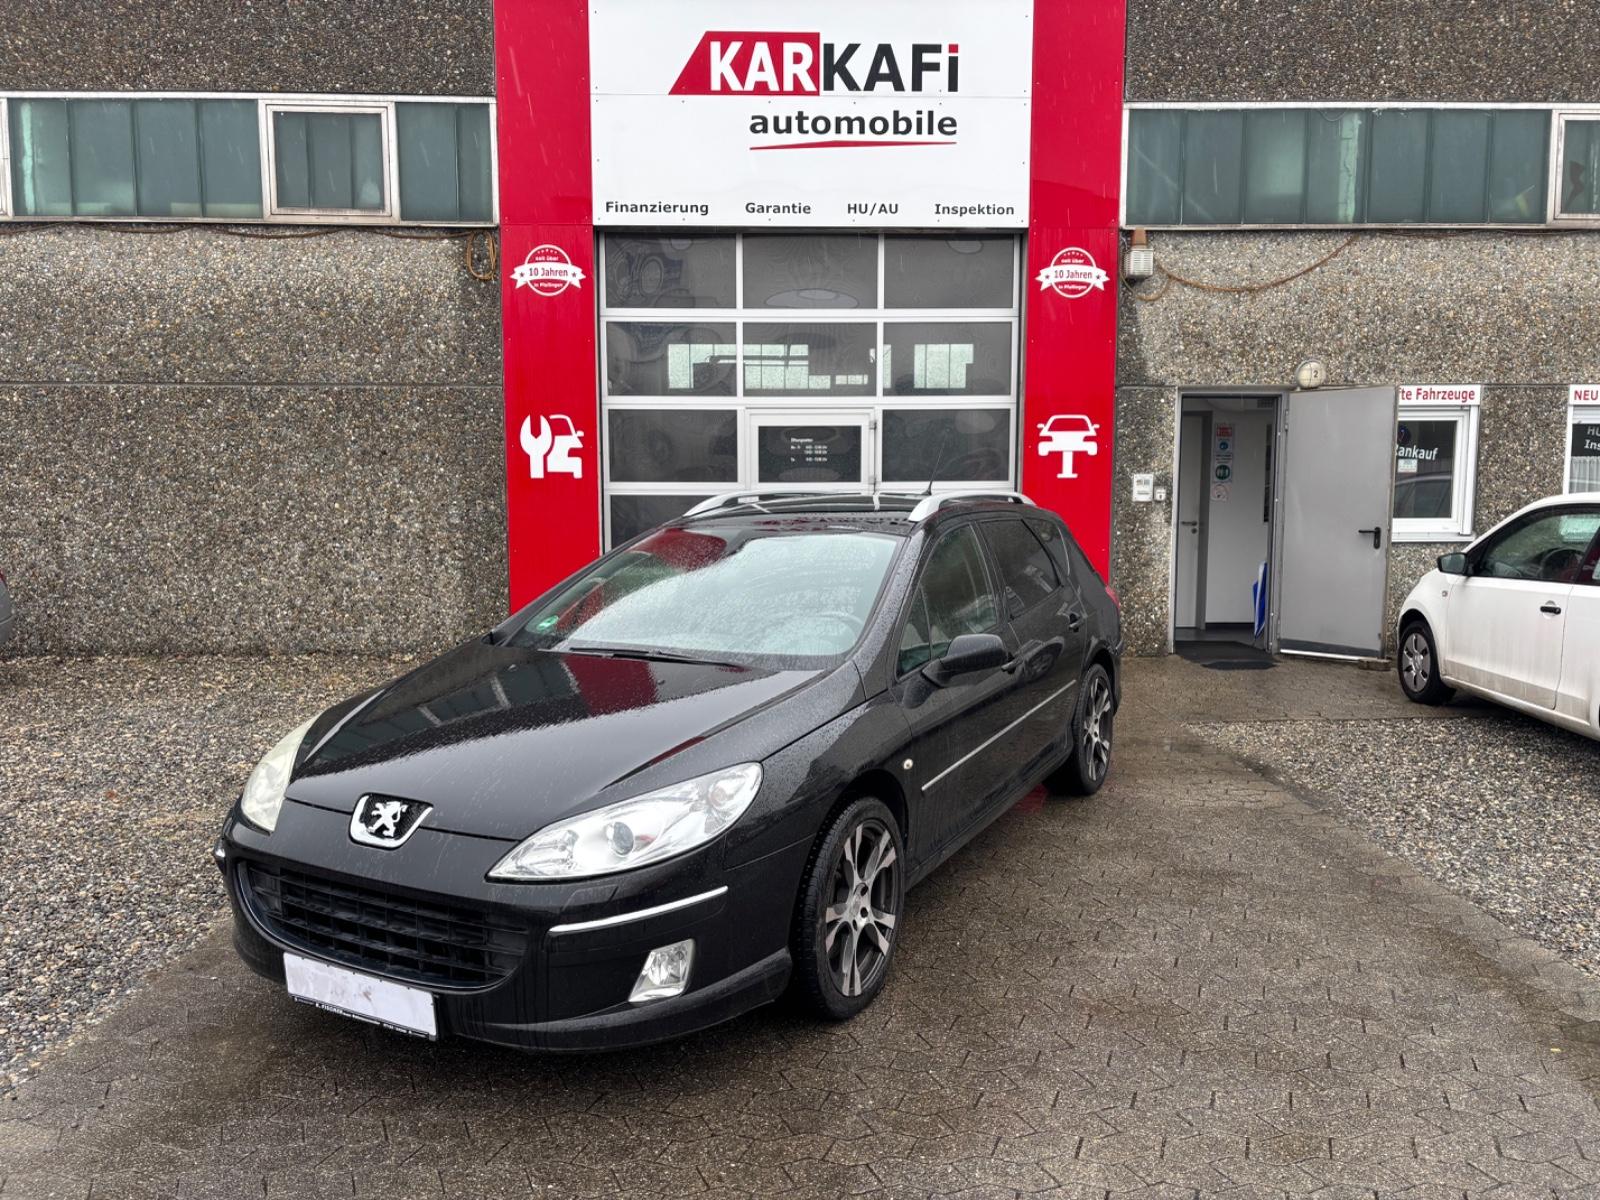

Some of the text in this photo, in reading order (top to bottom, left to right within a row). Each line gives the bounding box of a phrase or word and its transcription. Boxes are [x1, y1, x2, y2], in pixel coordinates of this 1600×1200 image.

[709, 41, 959, 93] KARKAFi
[749, 110, 958, 136] automobile
[605, 201, 710, 216] Finanzierung
[745, 202, 812, 215] Garantie
[847, 203, 900, 215] HU/AU
[934, 203, 1015, 216] Inspektion
[529, 267, 568, 277] 10 Jahren
[1054, 269, 1093, 279] 10 Jahren
[1313, 370, 1319, 378] 2
[1416, 388, 1475, 403] Fahrzeuge
[1574, 390, 1599, 401] NEU
